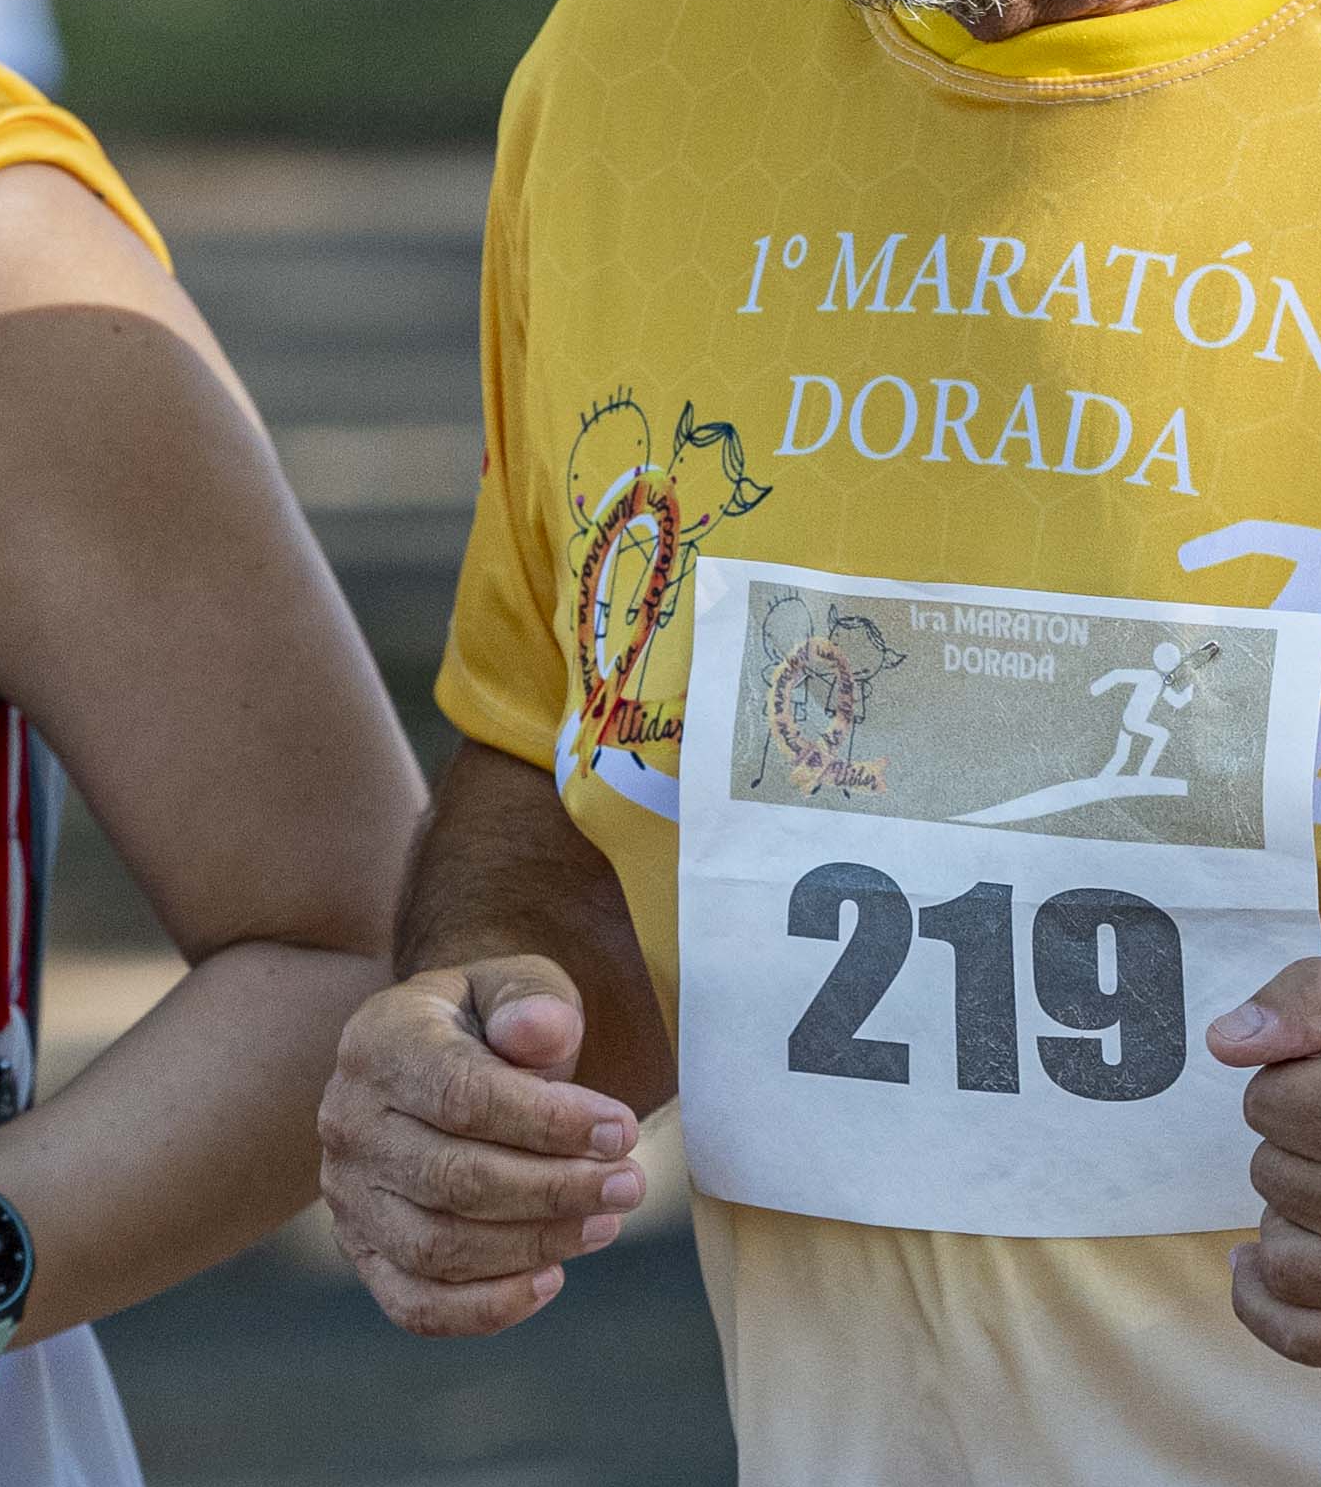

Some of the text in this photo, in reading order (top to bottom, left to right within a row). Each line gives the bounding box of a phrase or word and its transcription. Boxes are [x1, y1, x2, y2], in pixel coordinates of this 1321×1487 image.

[772, 373, 1201, 497] DORADA
[943, 640, 1056, 683] DORADA
[953, 605, 1090, 649] MARATON
[786, 860, 1188, 1103] 219
